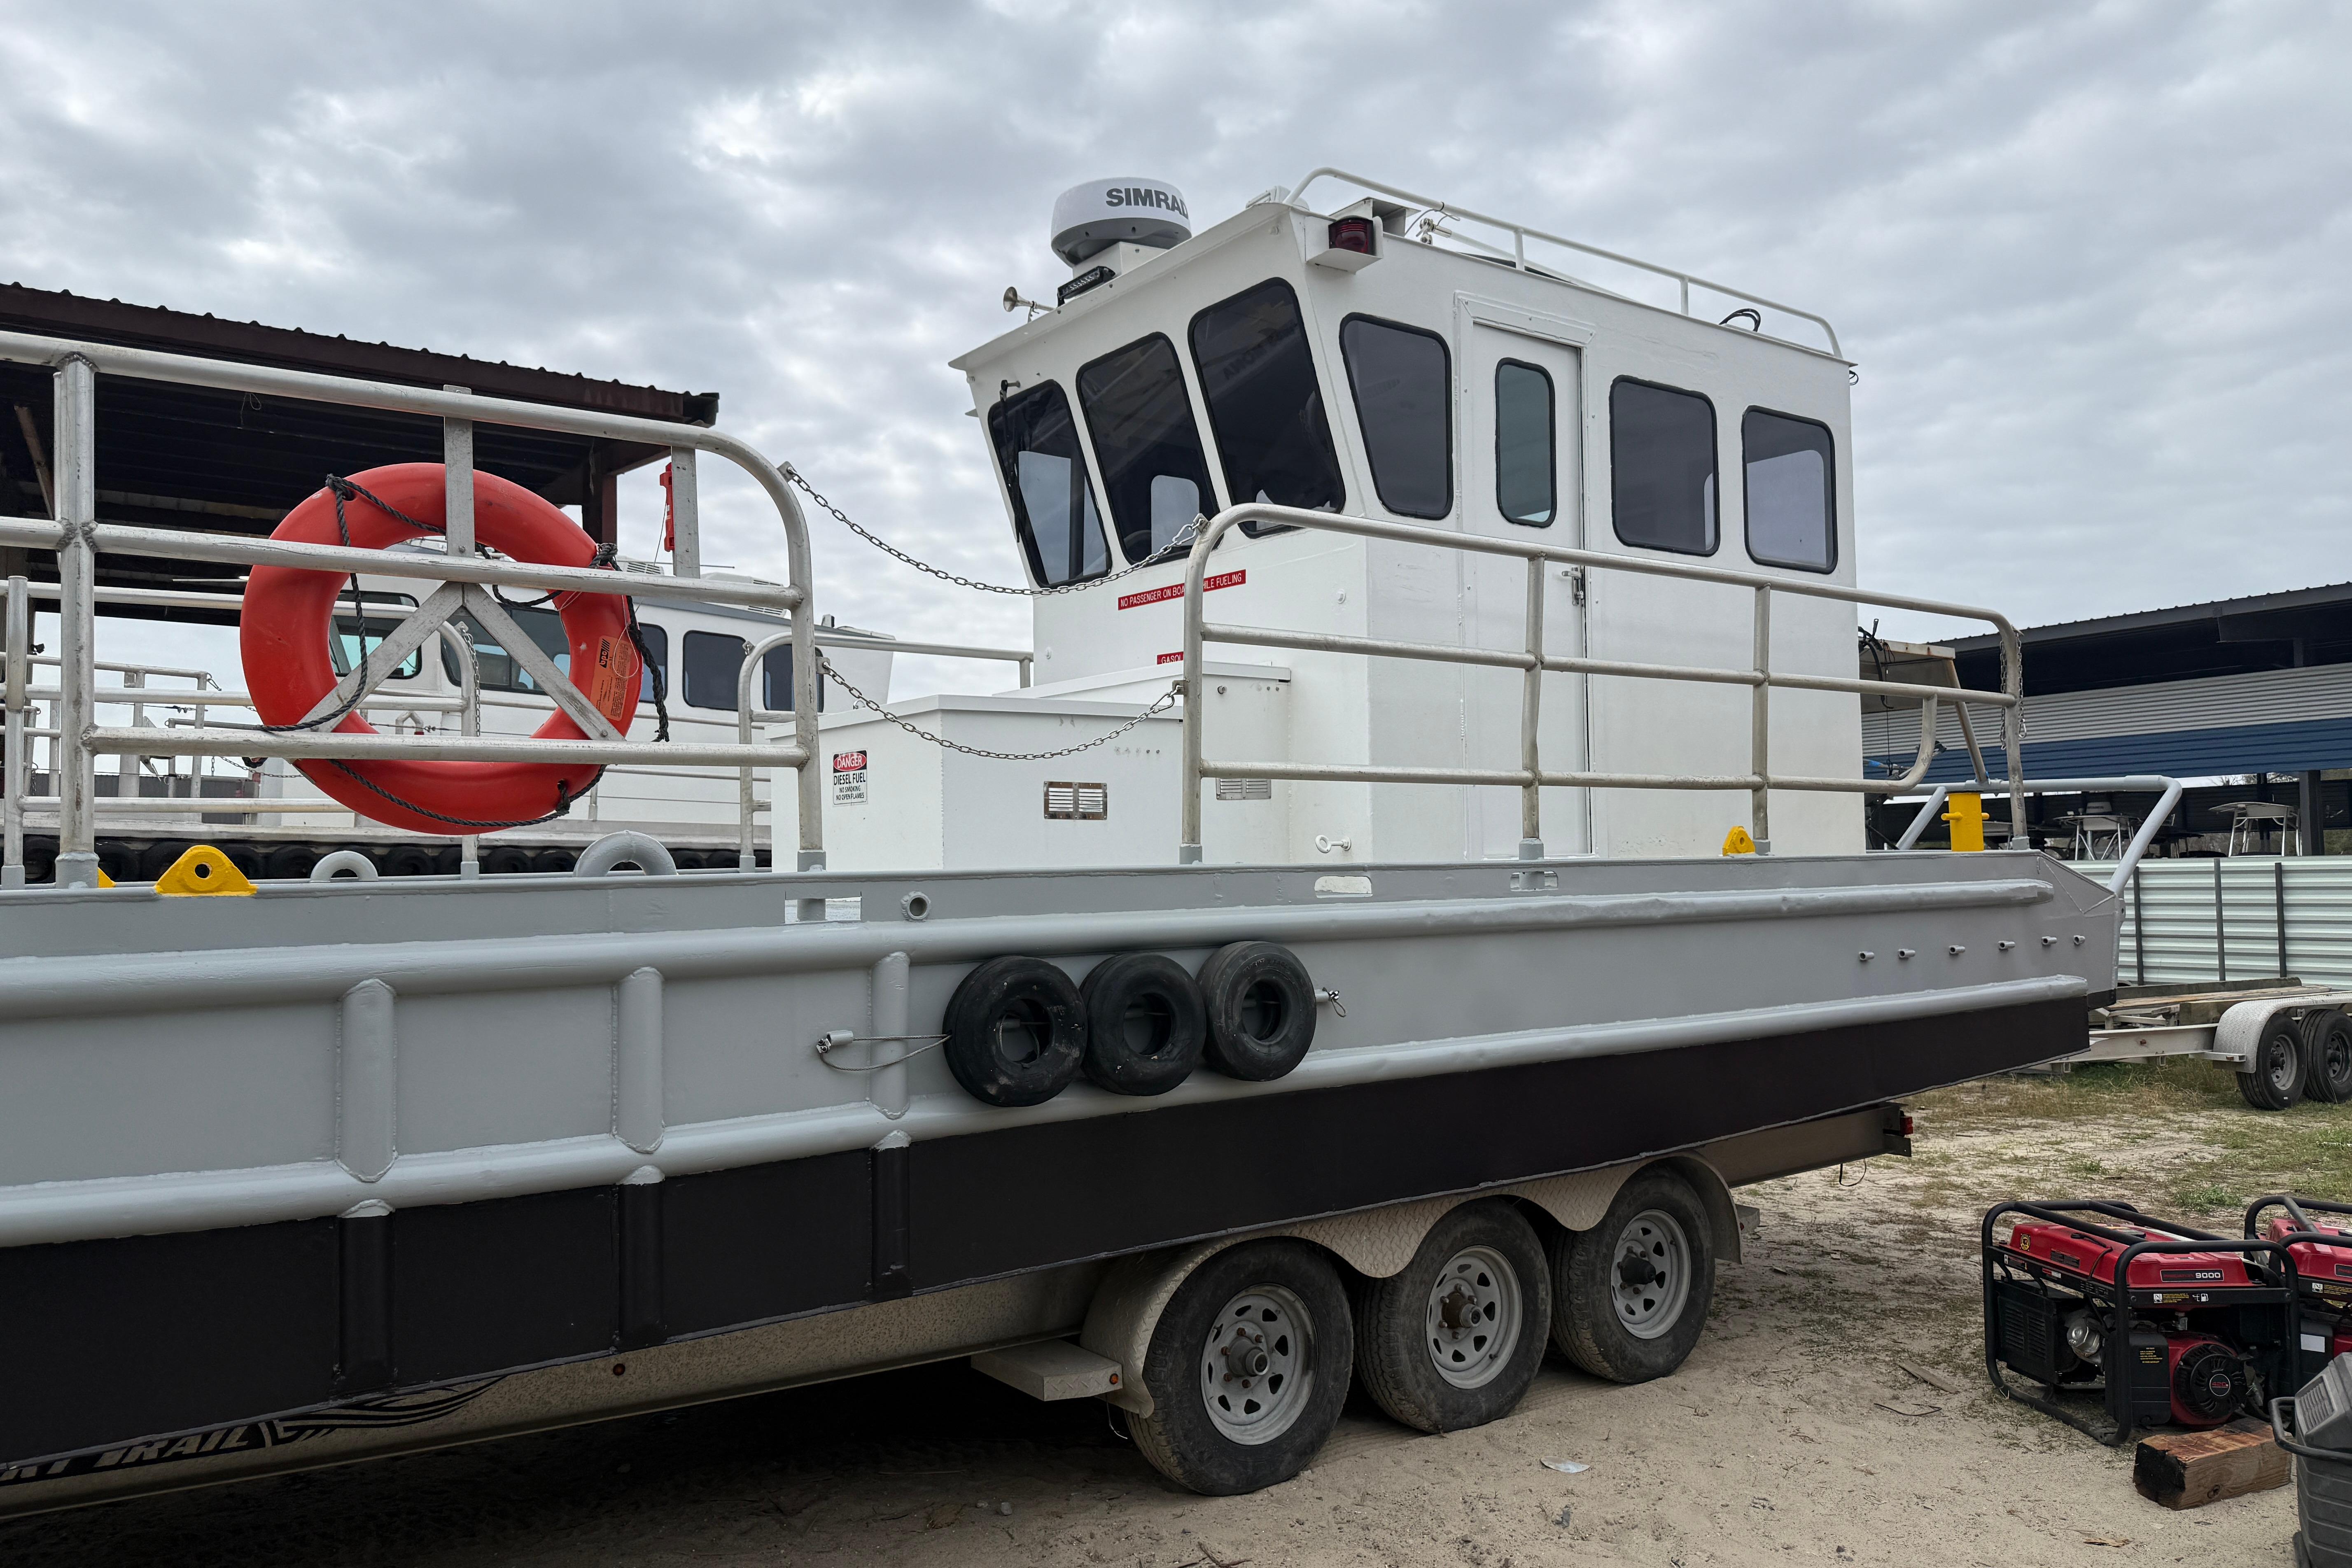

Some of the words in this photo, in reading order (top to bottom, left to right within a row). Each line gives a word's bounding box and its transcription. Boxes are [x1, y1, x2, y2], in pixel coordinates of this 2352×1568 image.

[1106, 188, 1189, 219] SIMRAD
[1120, 597, 1128, 607] NO
[1129, 590, 1161, 605] PASSENGER
[1163, 588, 1171, 598] ON
[1173, 585, 1185, 596] BOA
[1216, 573, 1241, 587] FUELING
[837, 756, 862, 769] DANGER
[834, 775, 851, 785] DIESEL
[853, 772, 866, 782] FUEL
